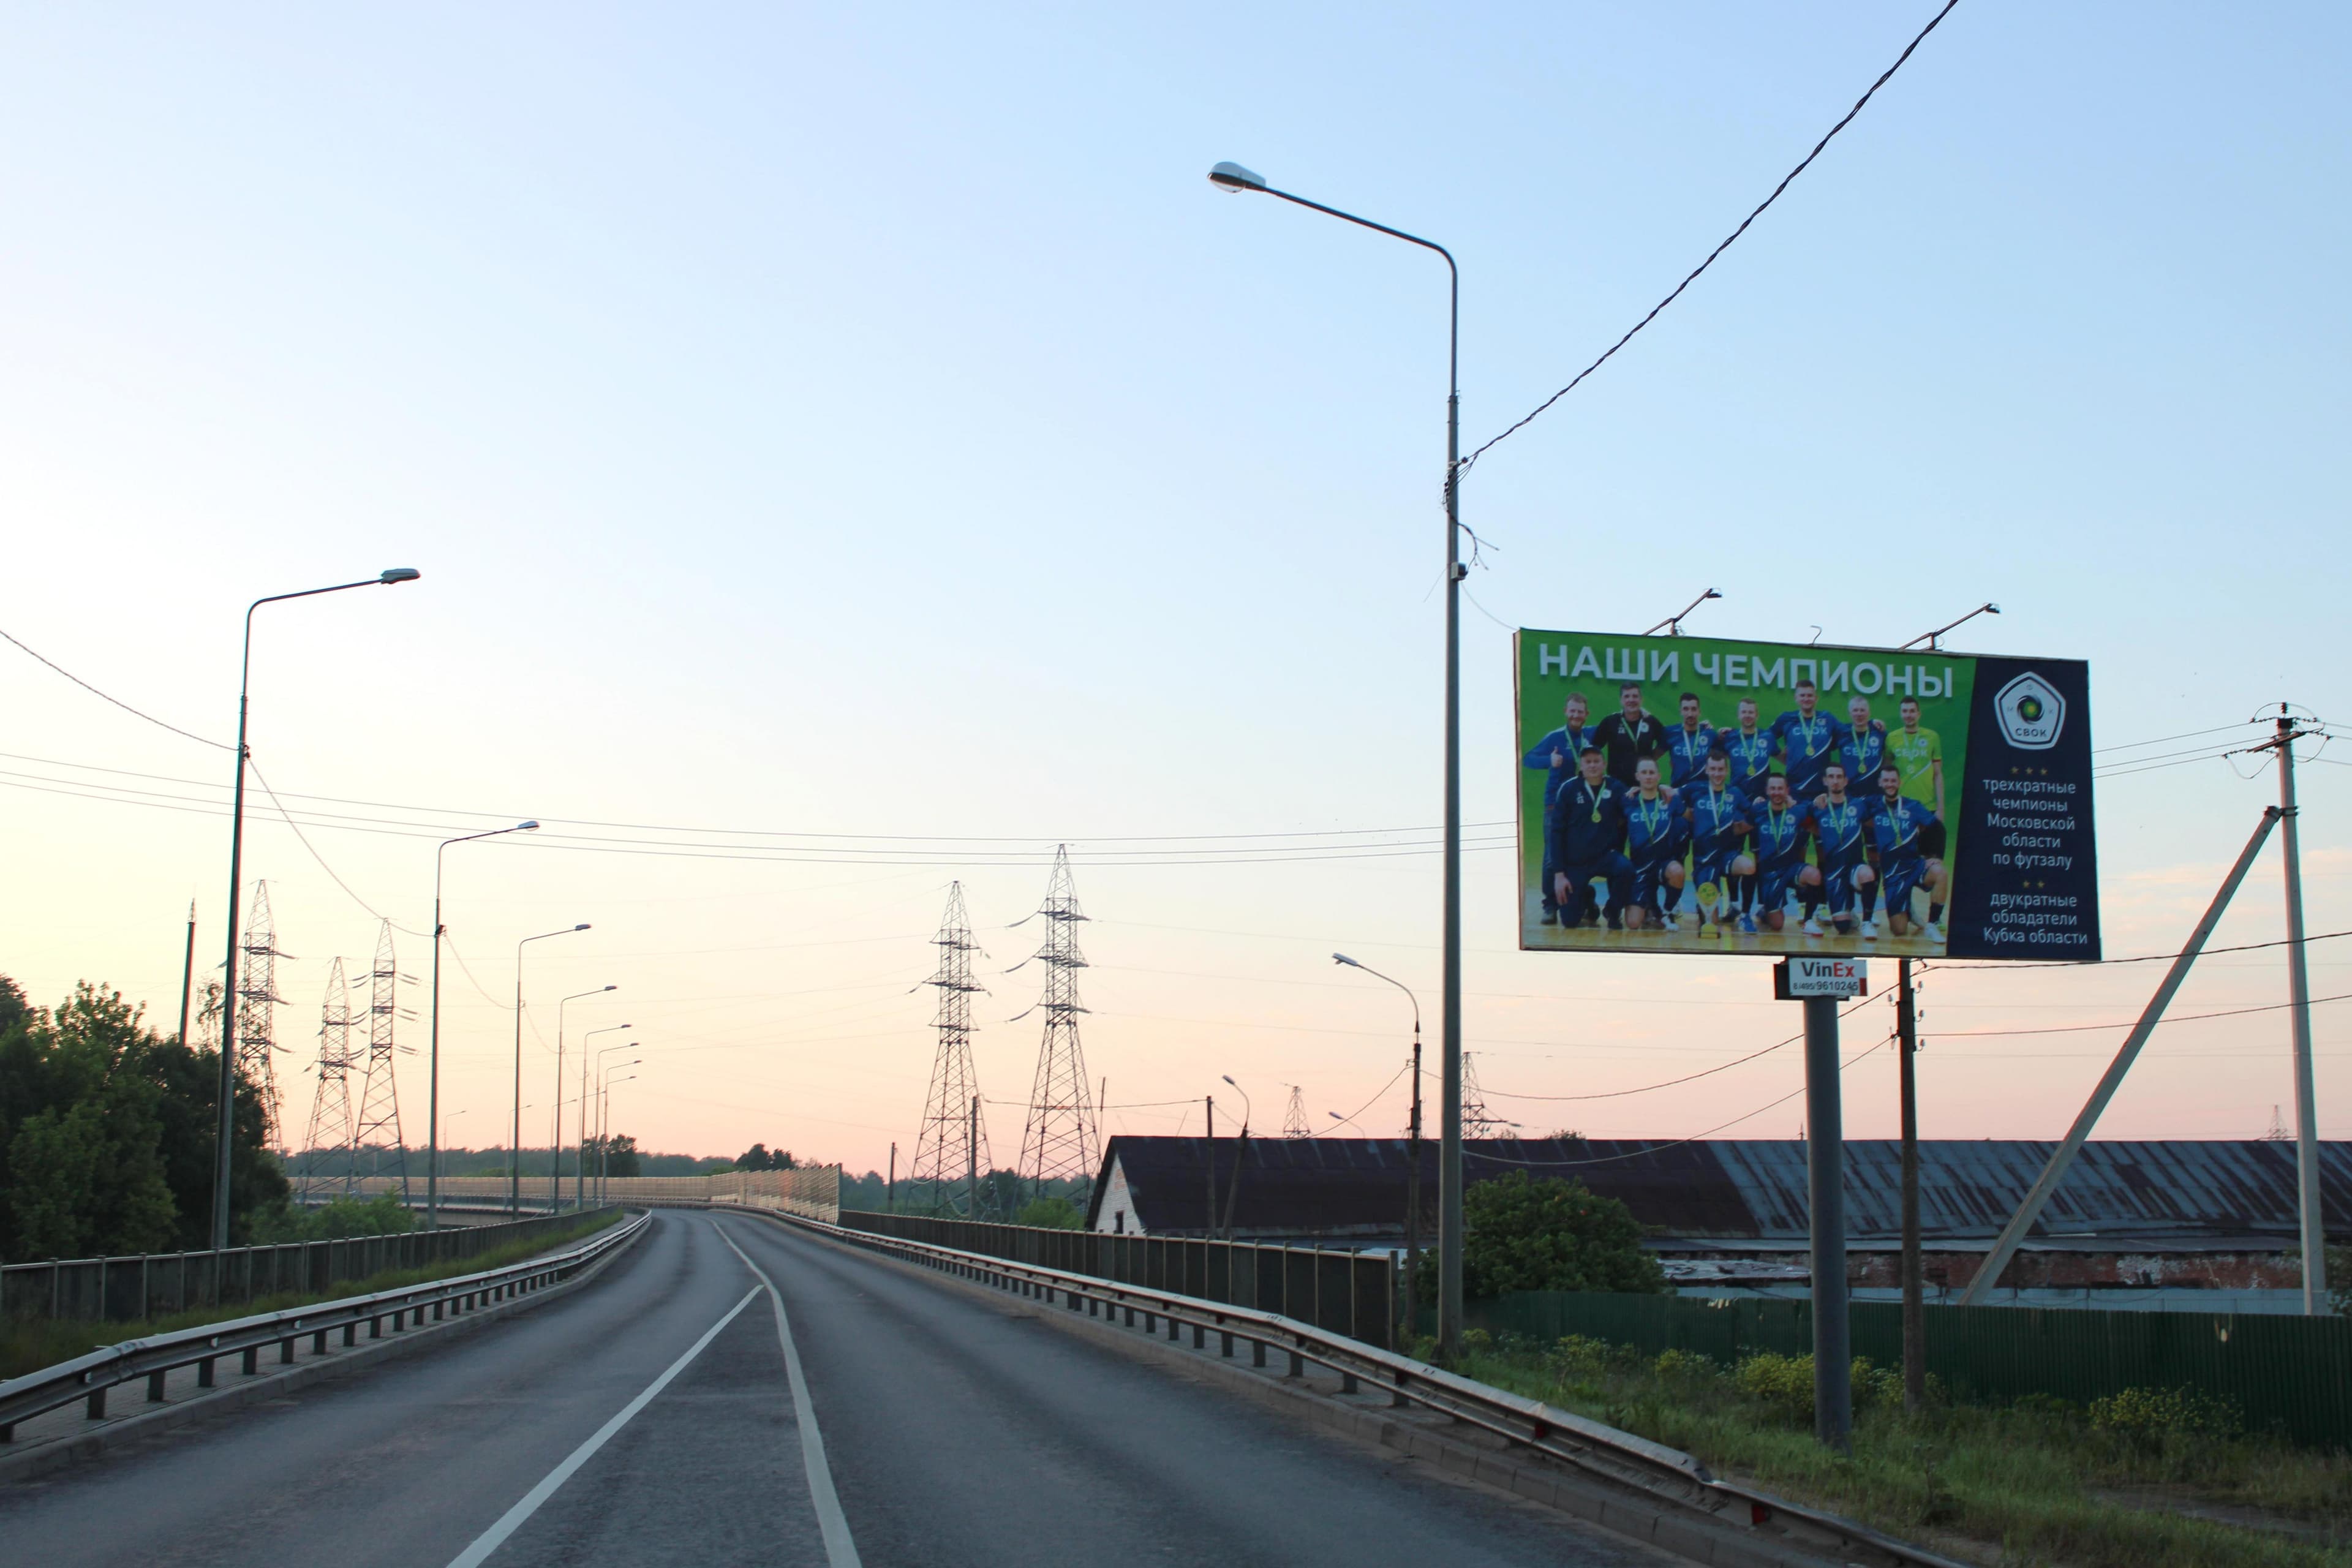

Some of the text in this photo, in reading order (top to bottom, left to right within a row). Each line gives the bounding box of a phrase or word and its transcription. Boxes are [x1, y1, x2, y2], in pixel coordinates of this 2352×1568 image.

[1539, 643, 1954, 698] НАШИ ЧЕМПИОНЫ
[2015, 728, 2047, 737] СВОК
[1983, 779, 2077, 795] трехкратные
[1992, 797, 2068, 812] чемпионы
[1987, 813, 2075, 830] Московской
[2002, 832, 2061, 848] области
[1993, 851, 2073, 870] по футзалу
[1990, 894, 2078, 909] двукратные
[1992, 909, 2078, 926] обладатели
[1983, 927, 2088, 945] Кубка области
[1801, 962, 1855, 977] VinEx
